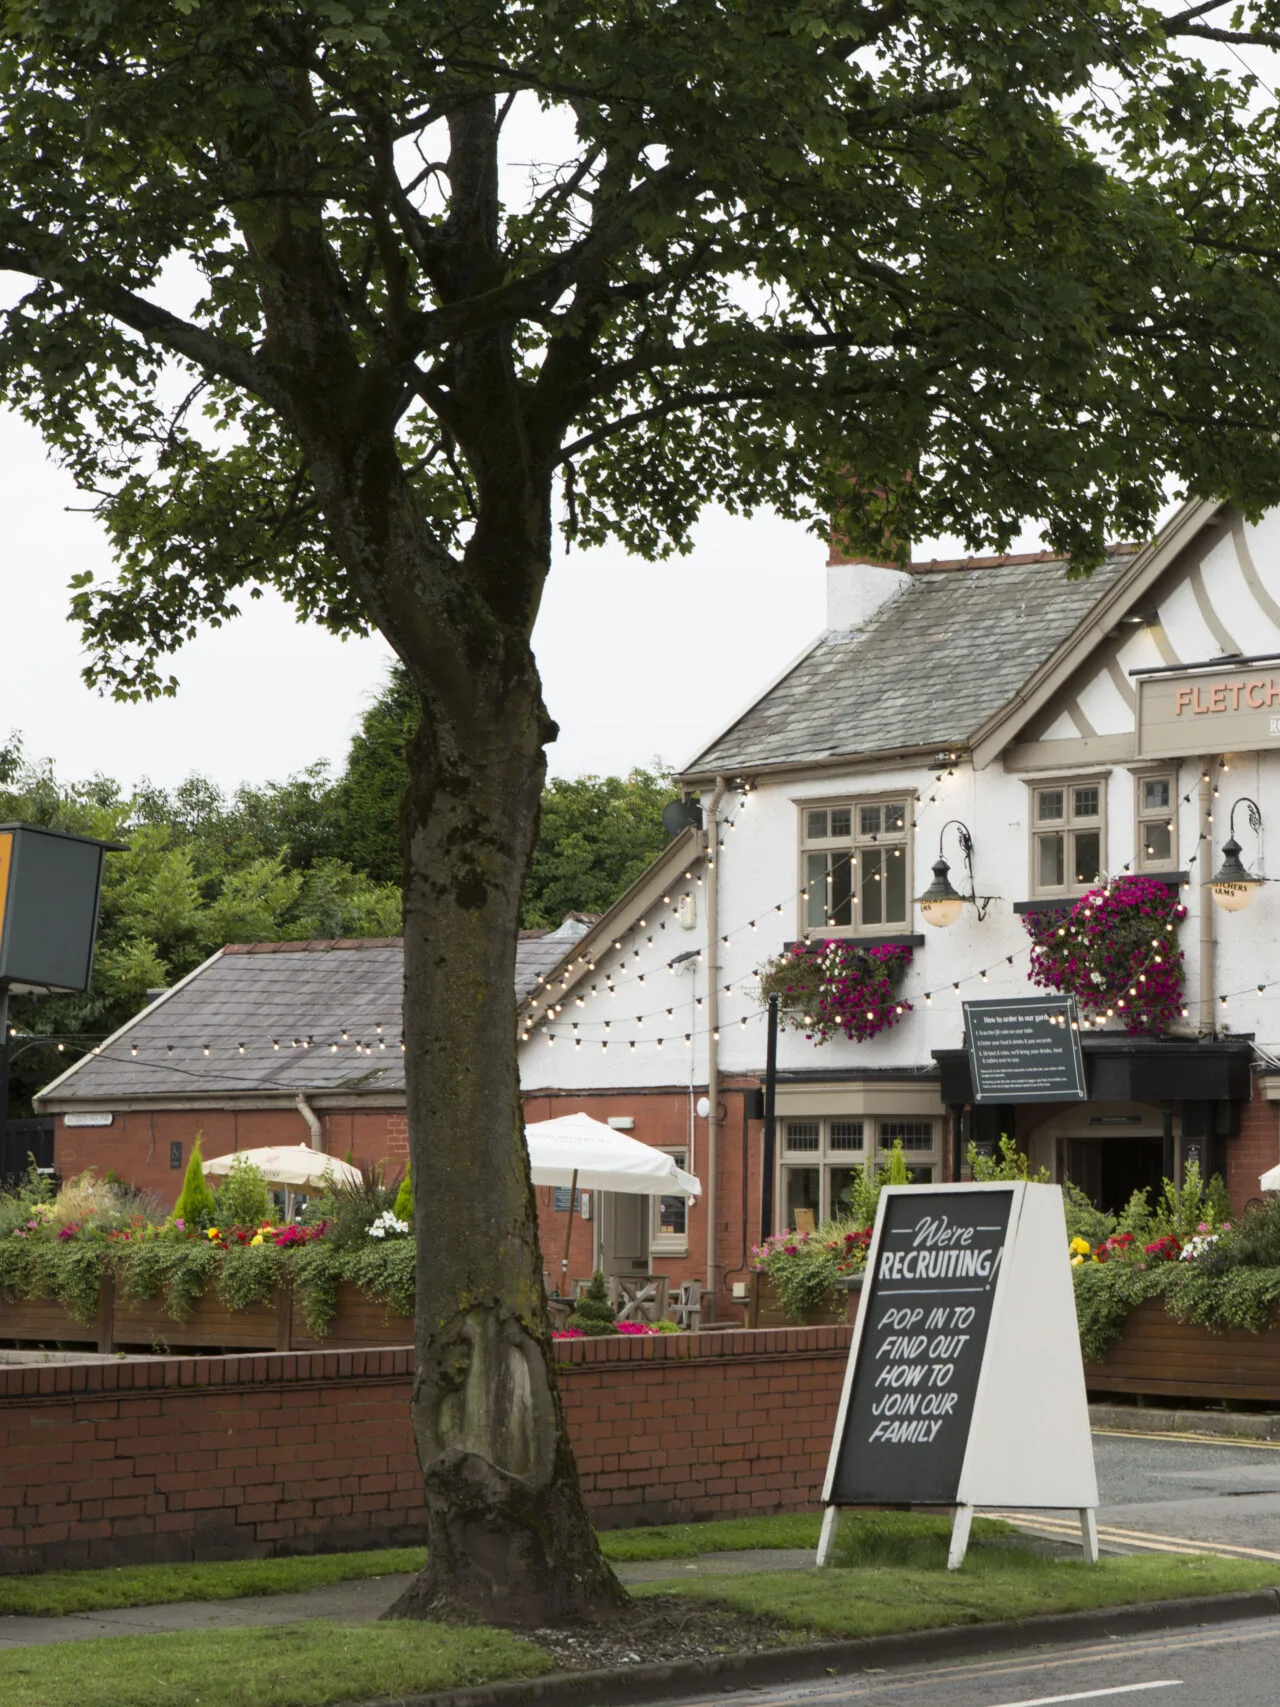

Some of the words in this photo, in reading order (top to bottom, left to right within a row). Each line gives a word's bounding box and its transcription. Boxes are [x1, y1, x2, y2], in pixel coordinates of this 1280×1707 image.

[912, 1215, 974, 1248] We're
[878, 1246, 1004, 1290] RECRUITING!
[877, 1308, 924, 1330] POP
[925, 1307, 950, 1330] IN
[950, 1306, 976, 1329] TO
[875, 1335, 928, 1360] FIND
[929, 1335, 970, 1358] OUT
[874, 1364, 929, 1388] HOW
[928, 1363, 954, 1387] TO
[871, 1393, 922, 1416] JOIN
[921, 1393, 958, 1415] OUR
[868, 1419, 943, 1443] FAMILY
